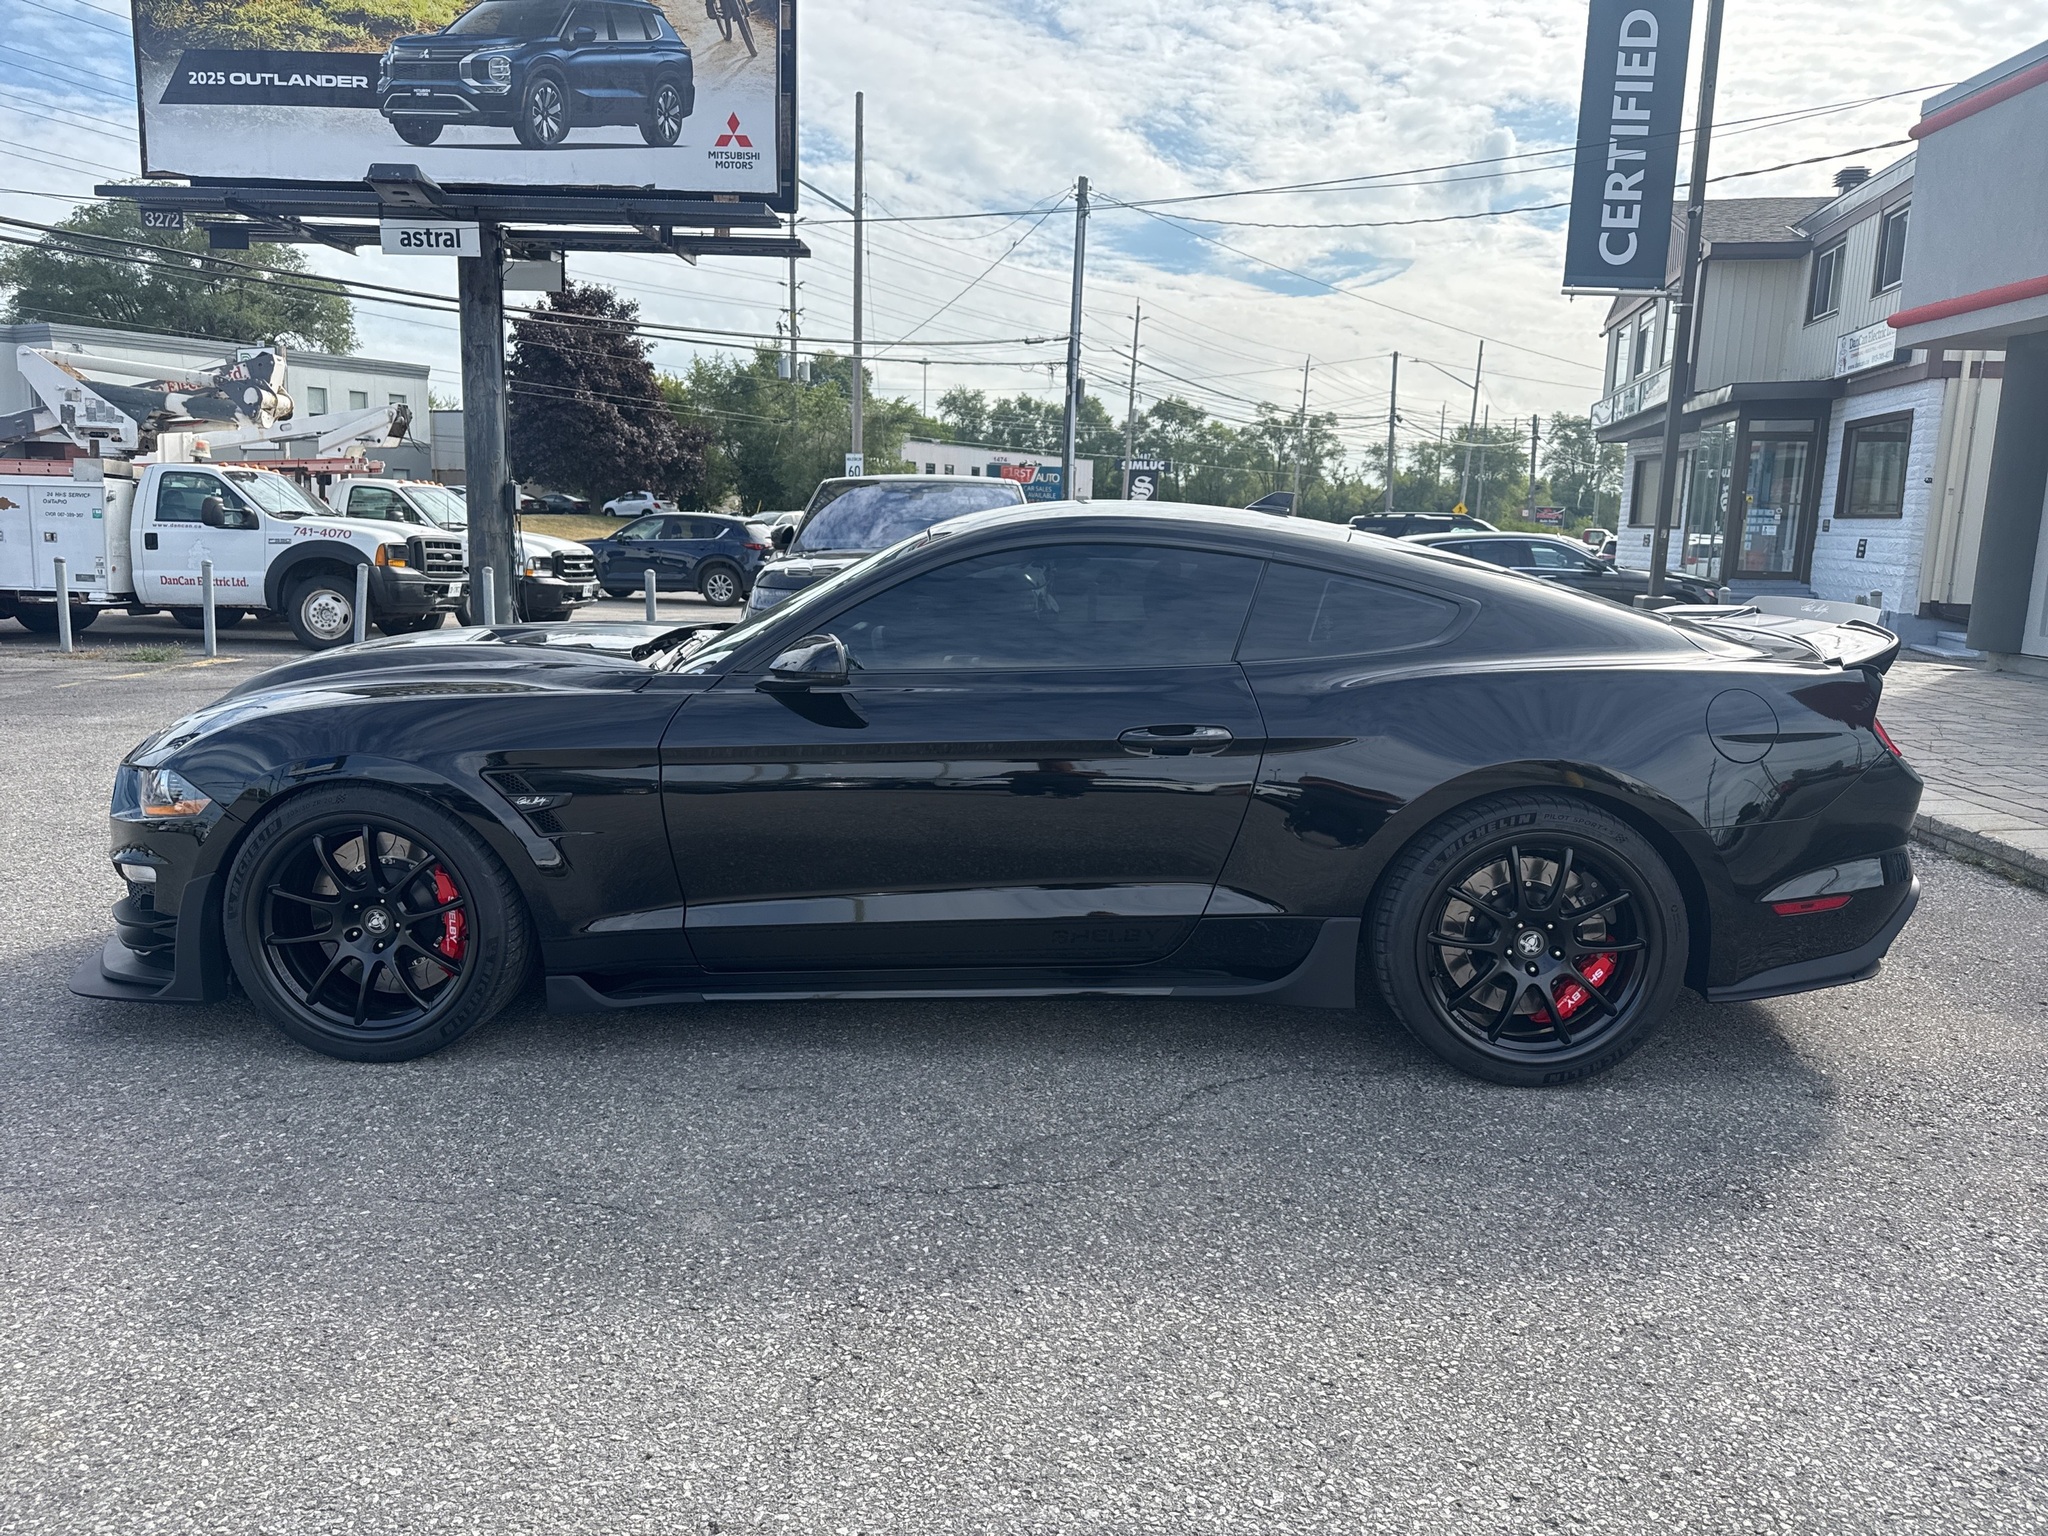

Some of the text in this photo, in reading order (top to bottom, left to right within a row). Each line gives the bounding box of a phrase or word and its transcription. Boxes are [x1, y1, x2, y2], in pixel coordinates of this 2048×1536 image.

[188, 72, 369, 88] 2025 OUTLANDER
[1598, 9, 1659, 266] CERTIFIED
[708, 151, 760, 160] MITSUBISHI
[715, 161, 753, 170] MOTORS
[145, 211, 180, 228] 3272
[400, 227, 461, 248] astral
[848, 465, 860, 477] 60
[1036, 473, 1060, 483] AUTO
[293, 526, 352, 539] 741-4070
[160, 576, 196, 586] DanCan
[232, 577, 249, 588] Ltd.
[1544, 813, 1570, 821] PILOT
[1443, 814, 1531, 859] MICHELIN
